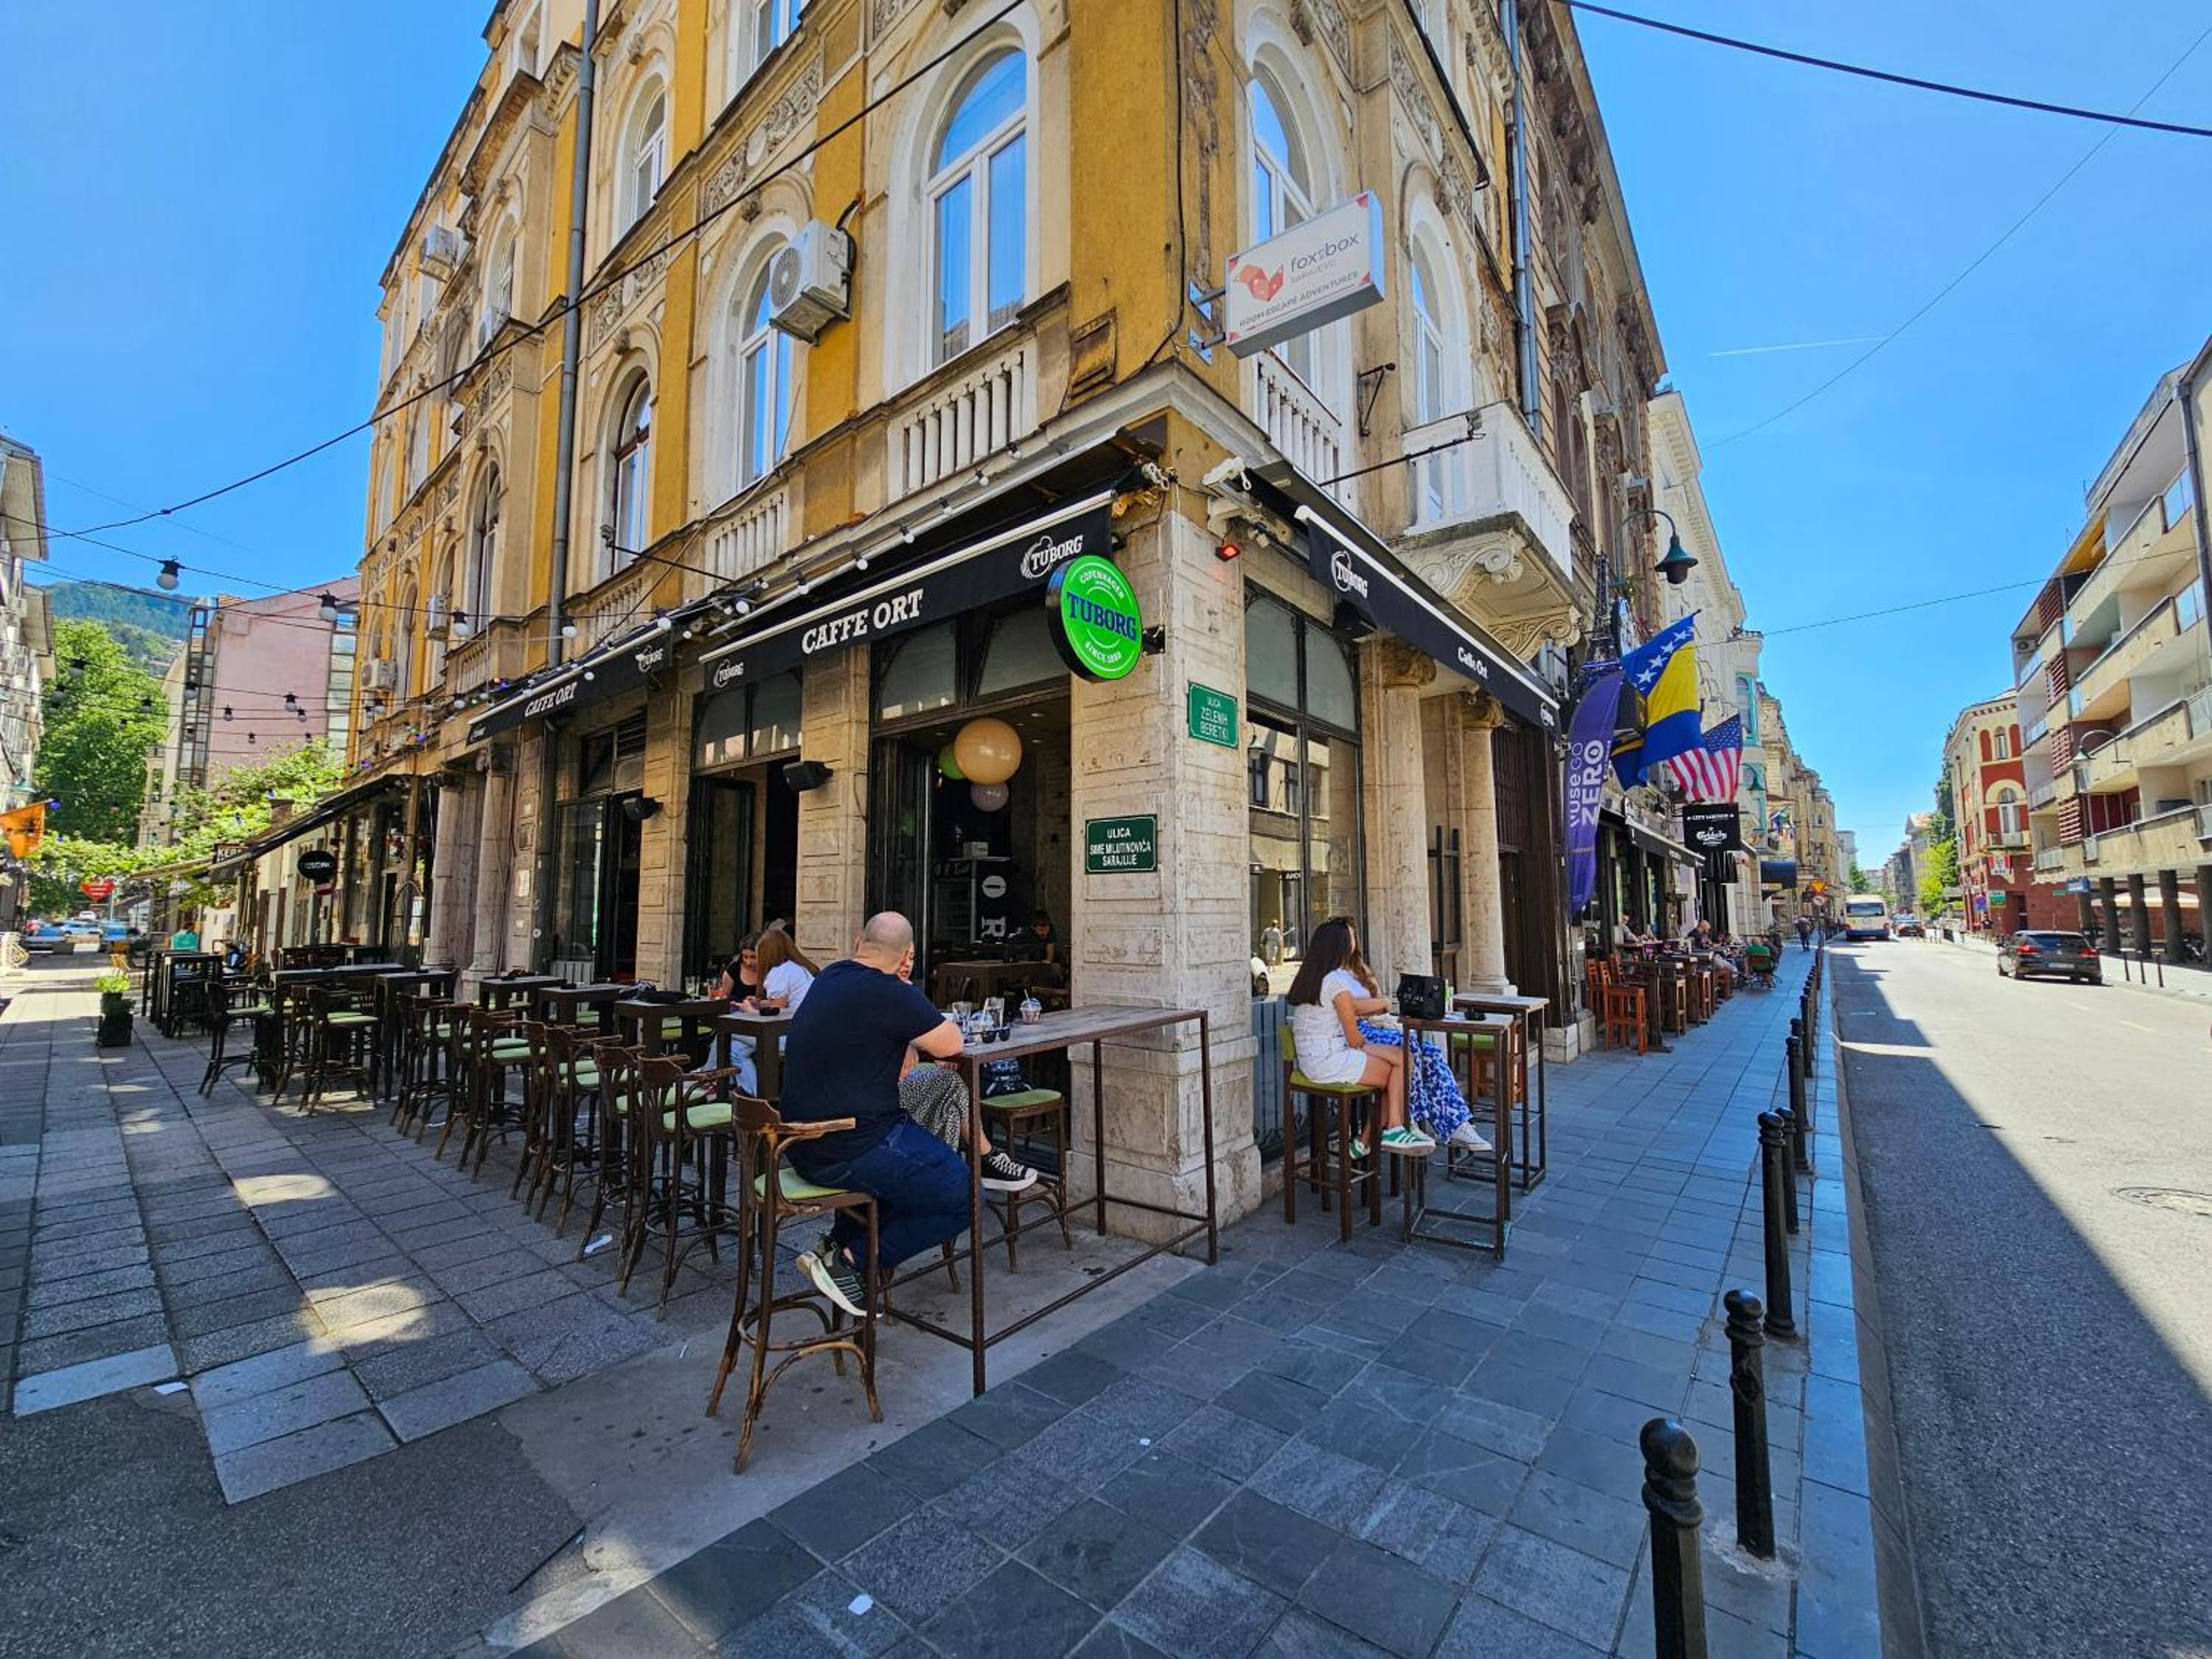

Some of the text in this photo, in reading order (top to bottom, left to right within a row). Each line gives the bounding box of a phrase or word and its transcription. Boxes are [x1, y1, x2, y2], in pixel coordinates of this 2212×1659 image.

[1239, 271, 1358, 327] ROOM ESCAPE ADVENTURES
[1030, 535, 1084, 571] TUBORG
[802, 588, 924, 655] CAFFE ORT
[1065, 590, 1137, 642] TUBORG
[524, 681, 578, 718] CAFFE ORT
[1571, 742, 1584, 771] GO
[1582, 740, 1604, 827] ZERO
[1107, 827, 1132, 838] ULICA
